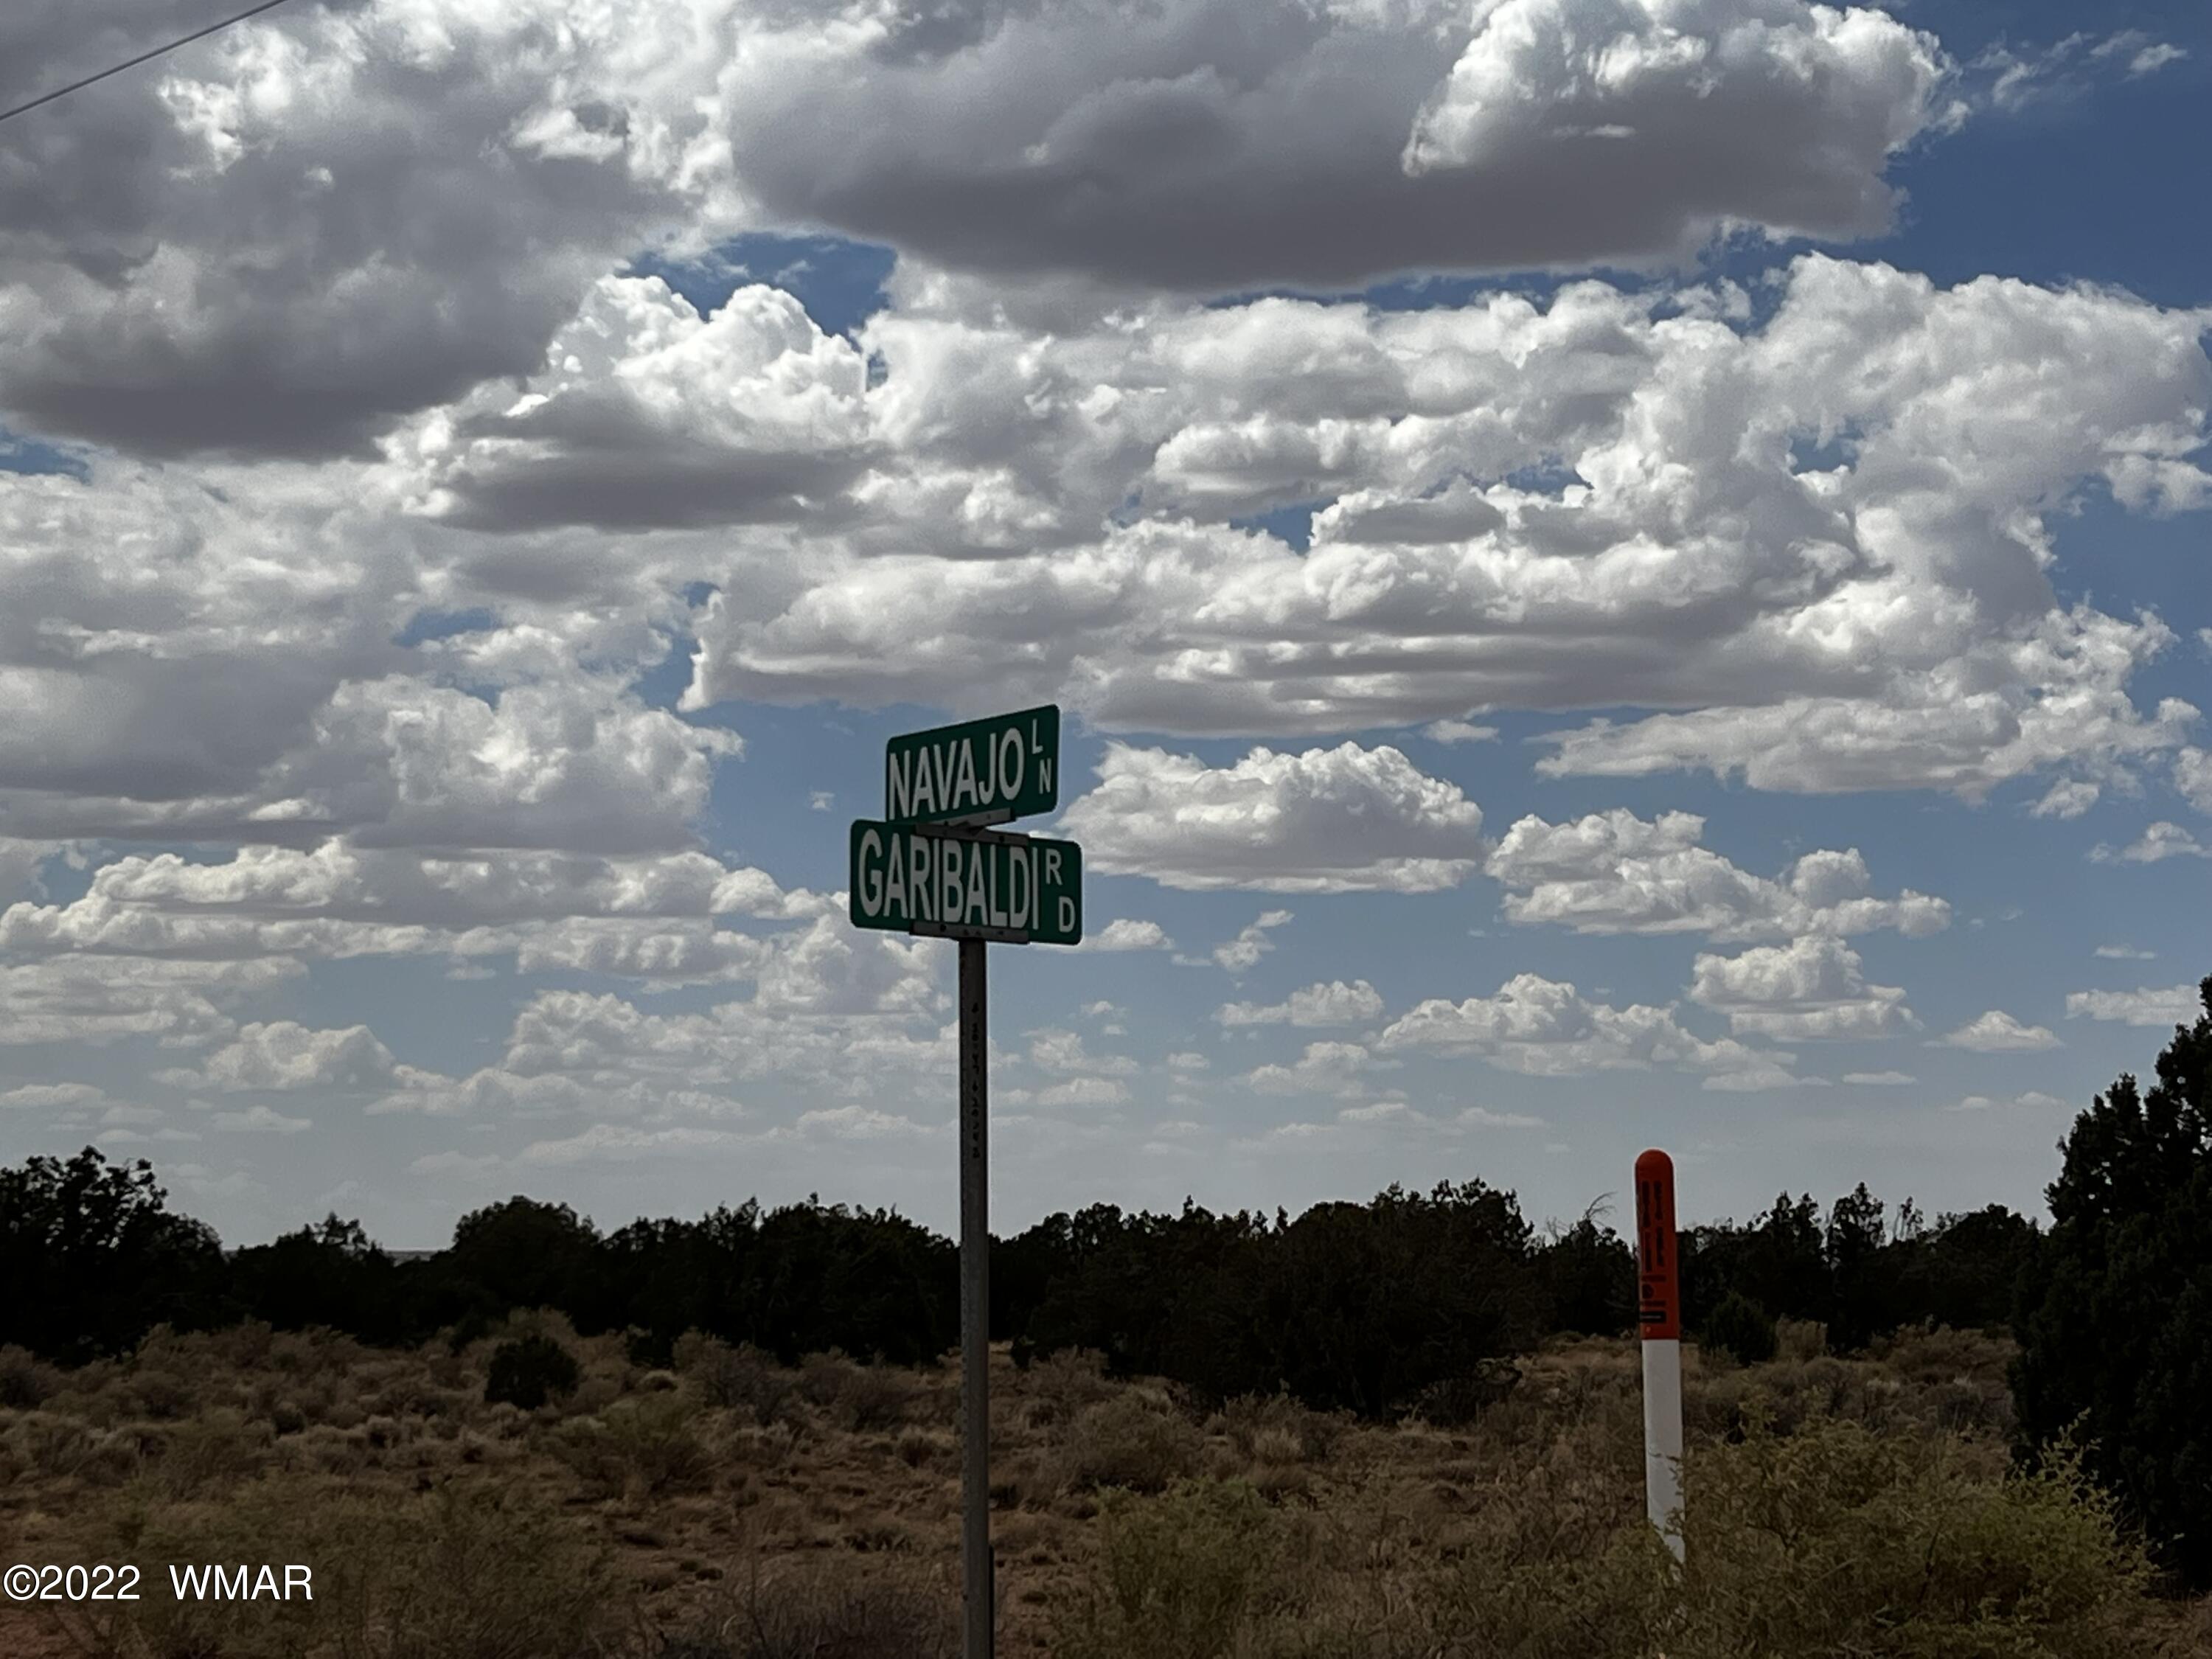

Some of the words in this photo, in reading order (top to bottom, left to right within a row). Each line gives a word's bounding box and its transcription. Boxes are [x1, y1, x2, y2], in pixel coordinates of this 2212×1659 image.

[888, 727, 1024, 821] NAVAJO
[1032, 717, 1052, 795] LN
[858, 828, 1039, 931] GARIBALDI
[1045, 848, 1077, 933] RD
